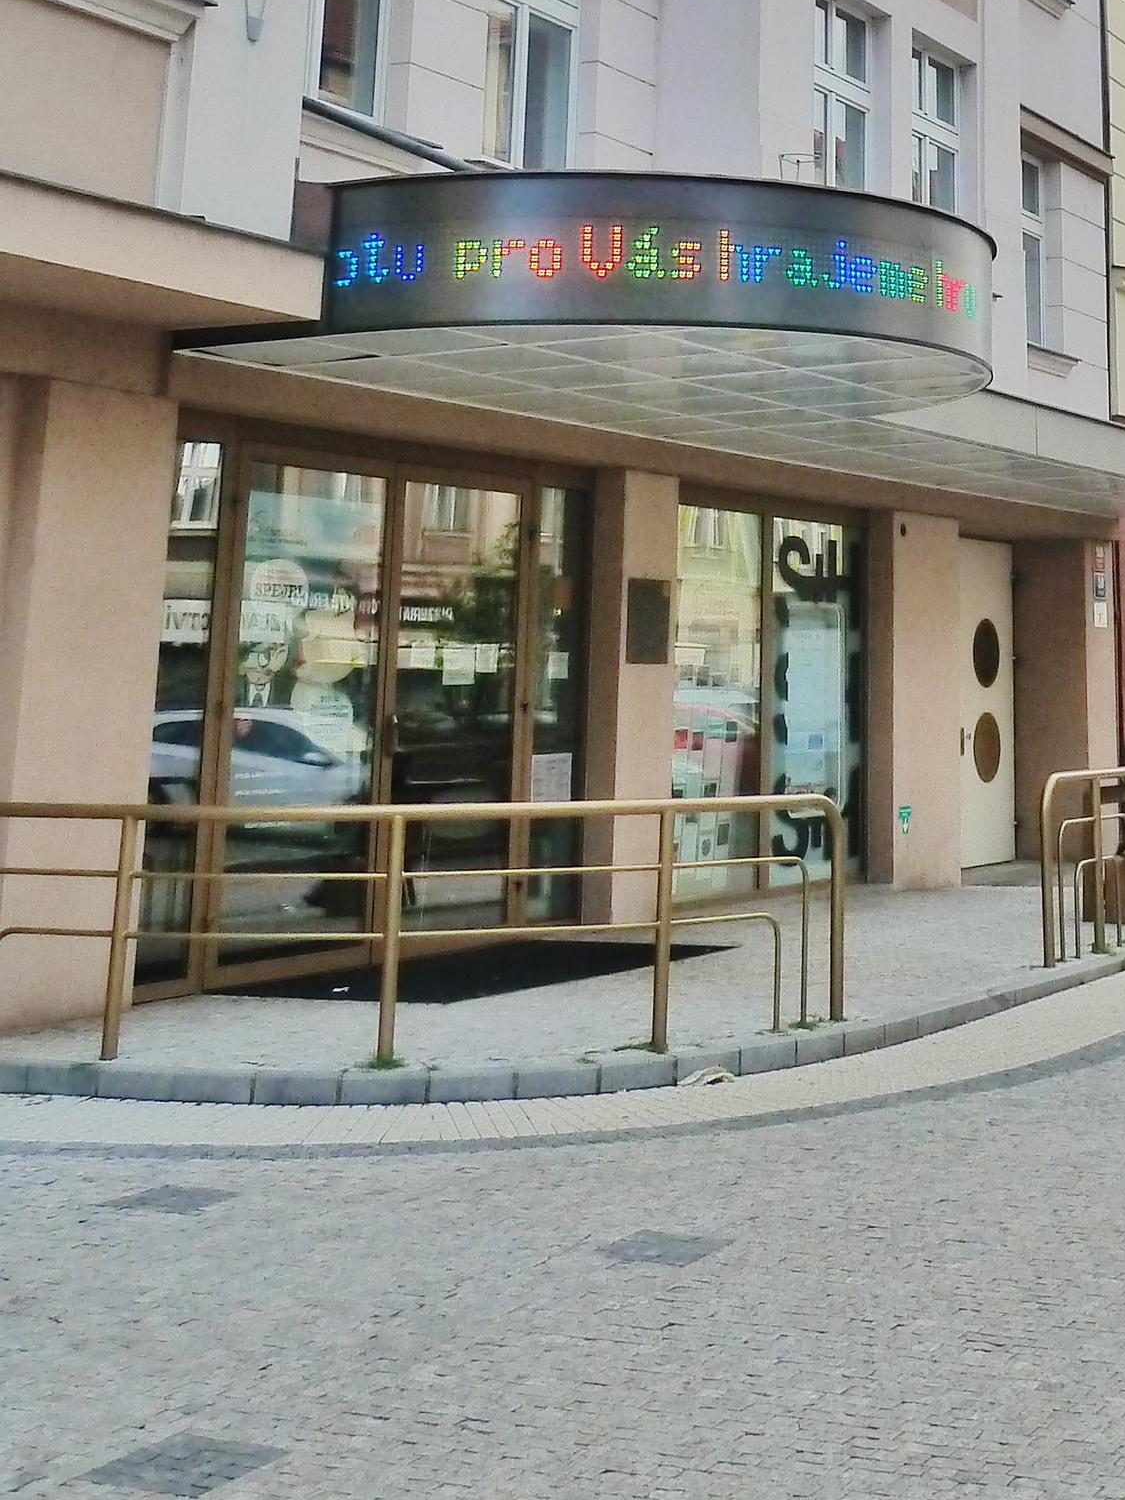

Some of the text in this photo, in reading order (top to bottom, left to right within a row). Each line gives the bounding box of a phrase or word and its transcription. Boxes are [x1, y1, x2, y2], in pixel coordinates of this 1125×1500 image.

[454, 239, 562, 280] pro
[581, 224, 701, 281] Vás
[719, 228, 928, 304] hrajeme
